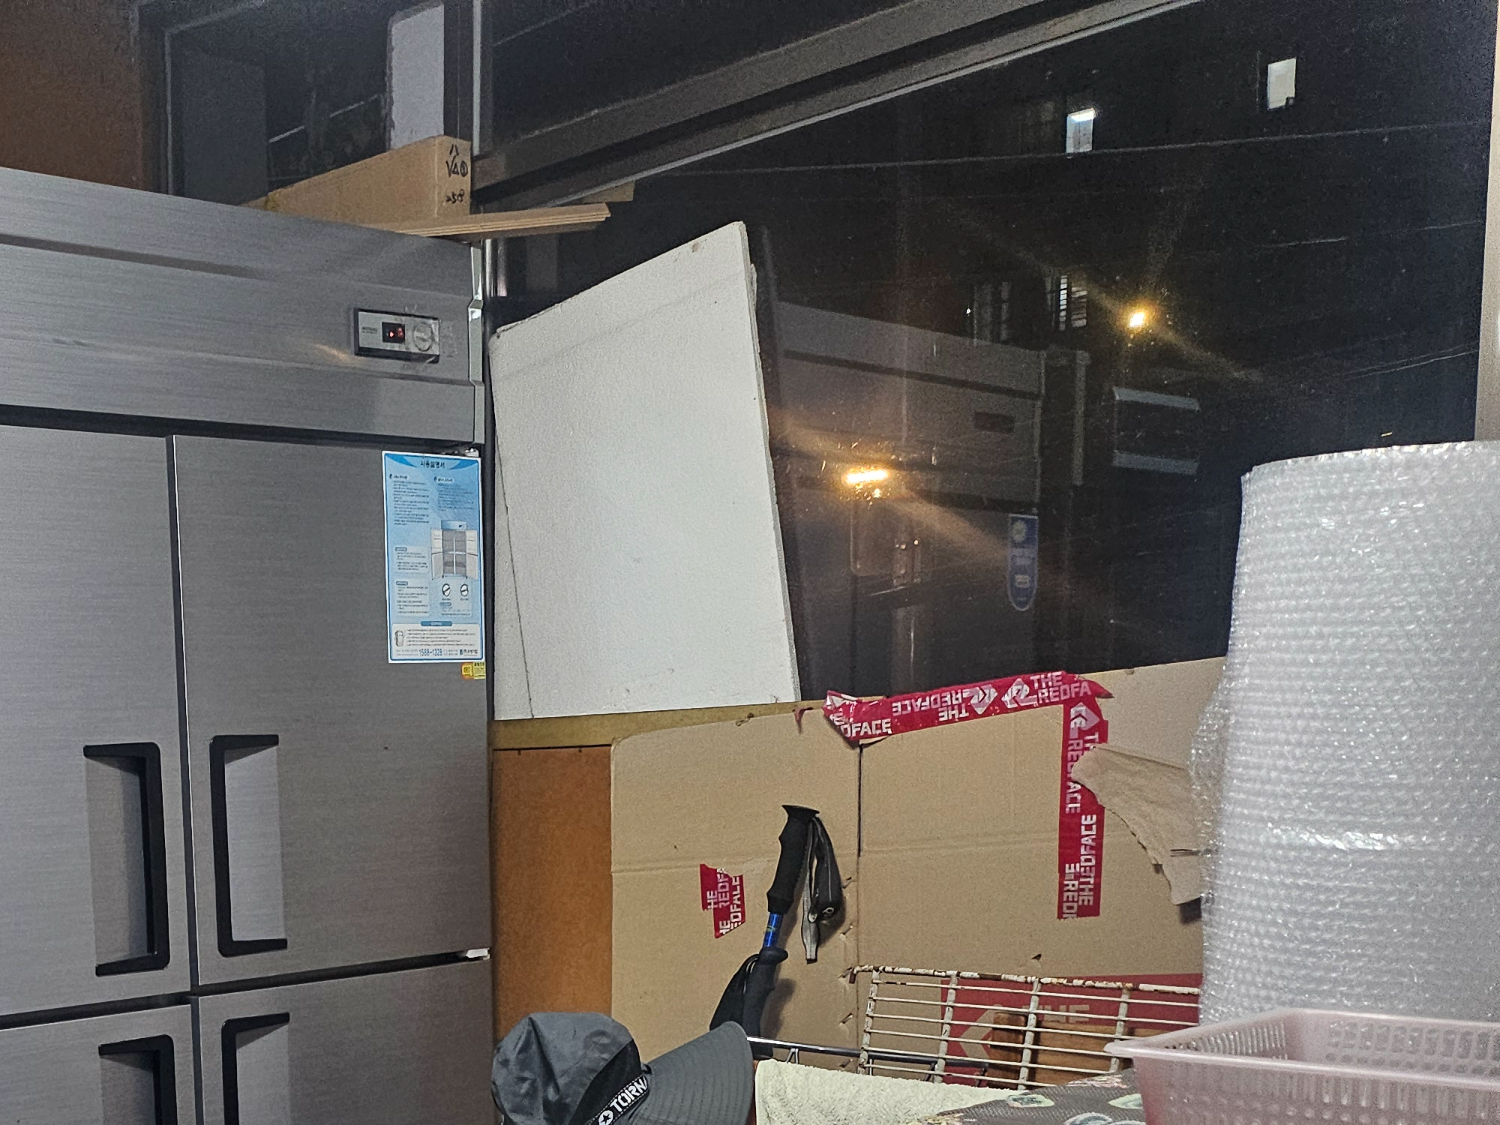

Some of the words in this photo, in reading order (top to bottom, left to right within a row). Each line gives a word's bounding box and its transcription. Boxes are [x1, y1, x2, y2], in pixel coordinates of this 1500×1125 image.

[1030, 671, 1063, 690] THE
[891, 688, 963, 717] REDFACE
[938, 704, 970, 722] THE
[609, 1076, 648, 1112] TORN
